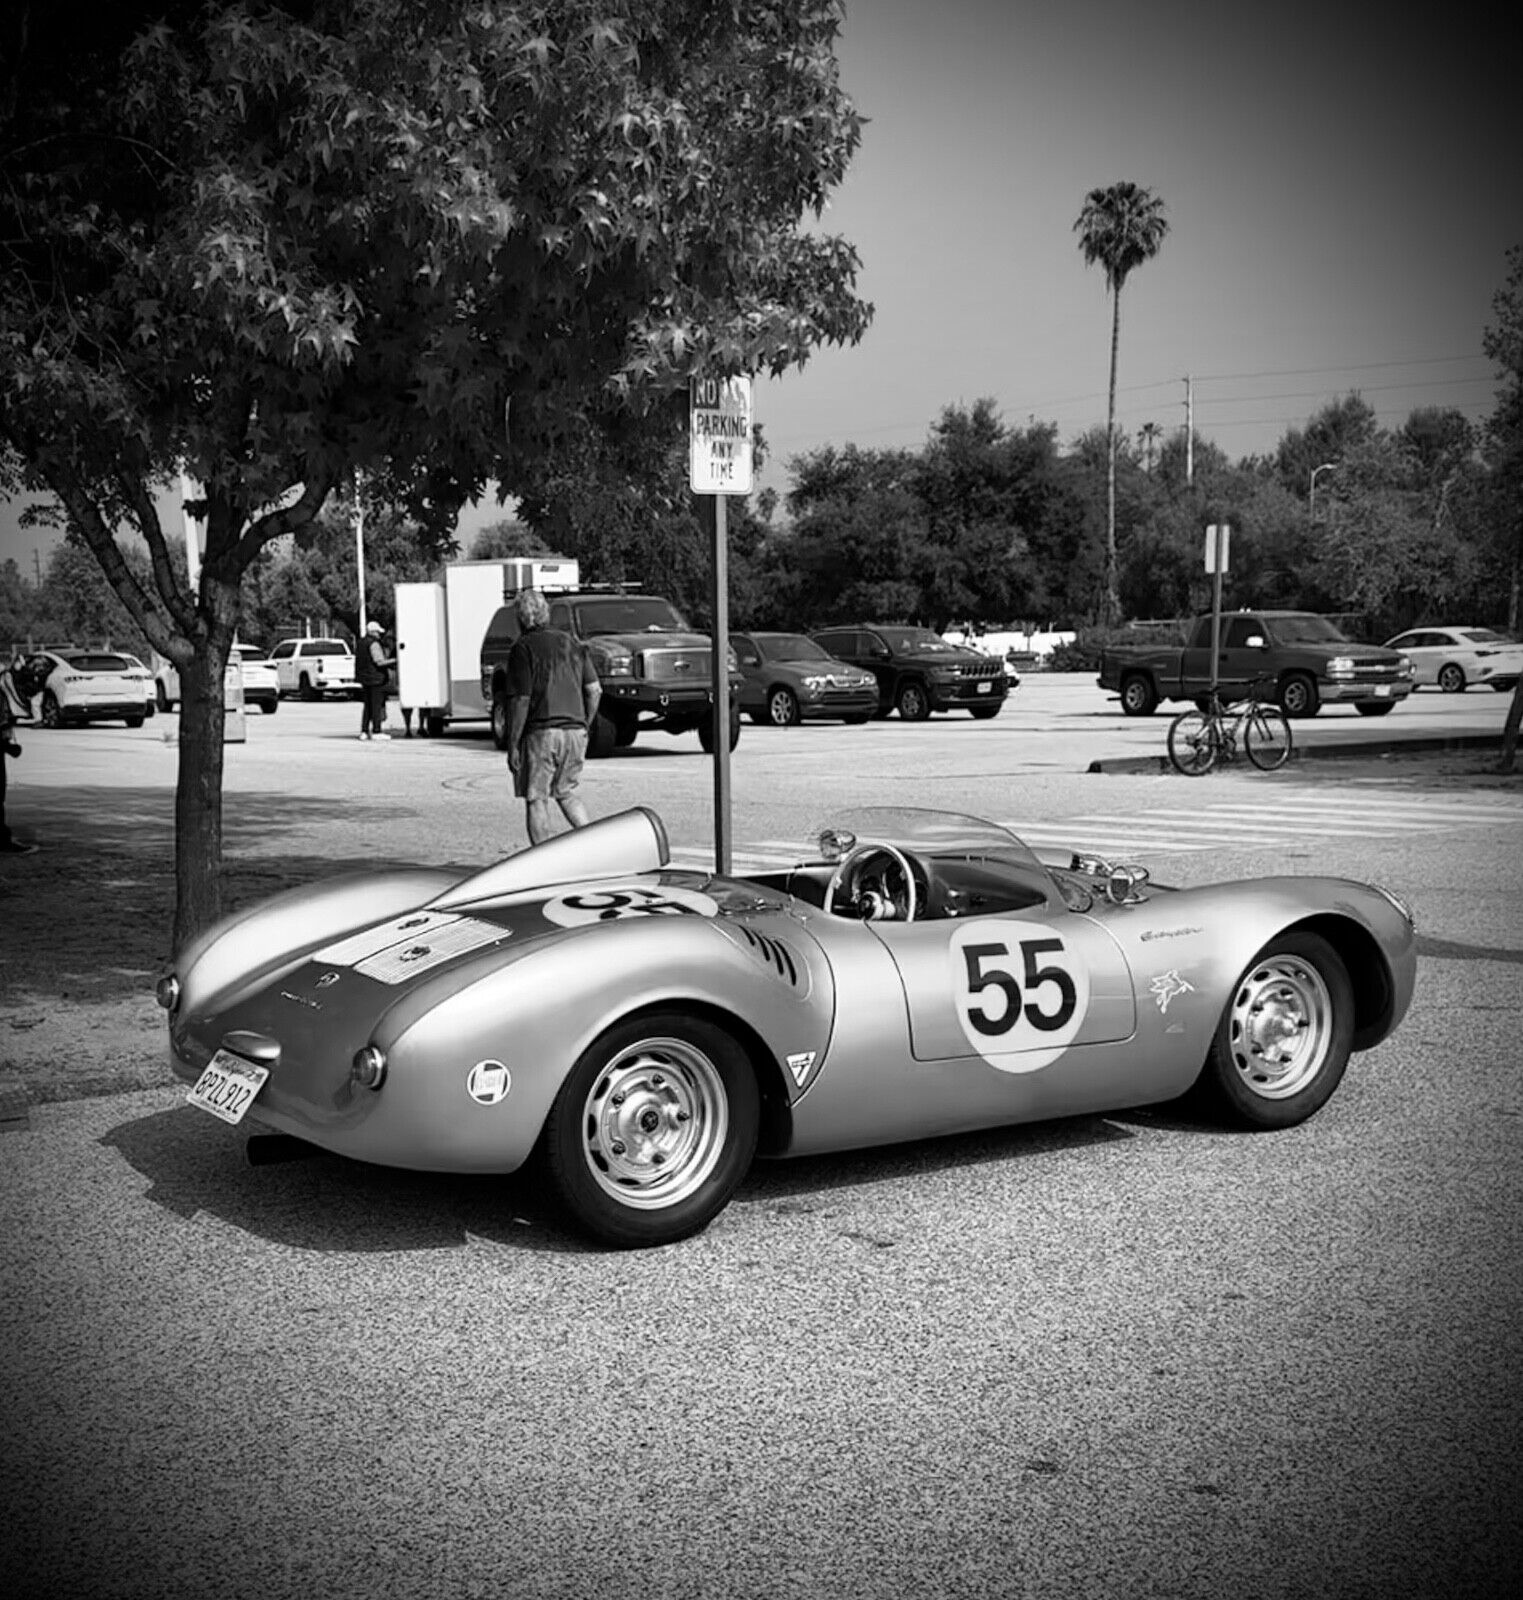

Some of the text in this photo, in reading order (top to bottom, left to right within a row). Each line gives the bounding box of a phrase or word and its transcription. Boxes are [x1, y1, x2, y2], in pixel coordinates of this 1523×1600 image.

[695, 378, 717, 405] NO
[696, 414, 747, 438] PARKING
[711, 441, 733, 459] ANY
[710, 462, 734, 480] TIME
[961, 938, 1077, 1036] 55
